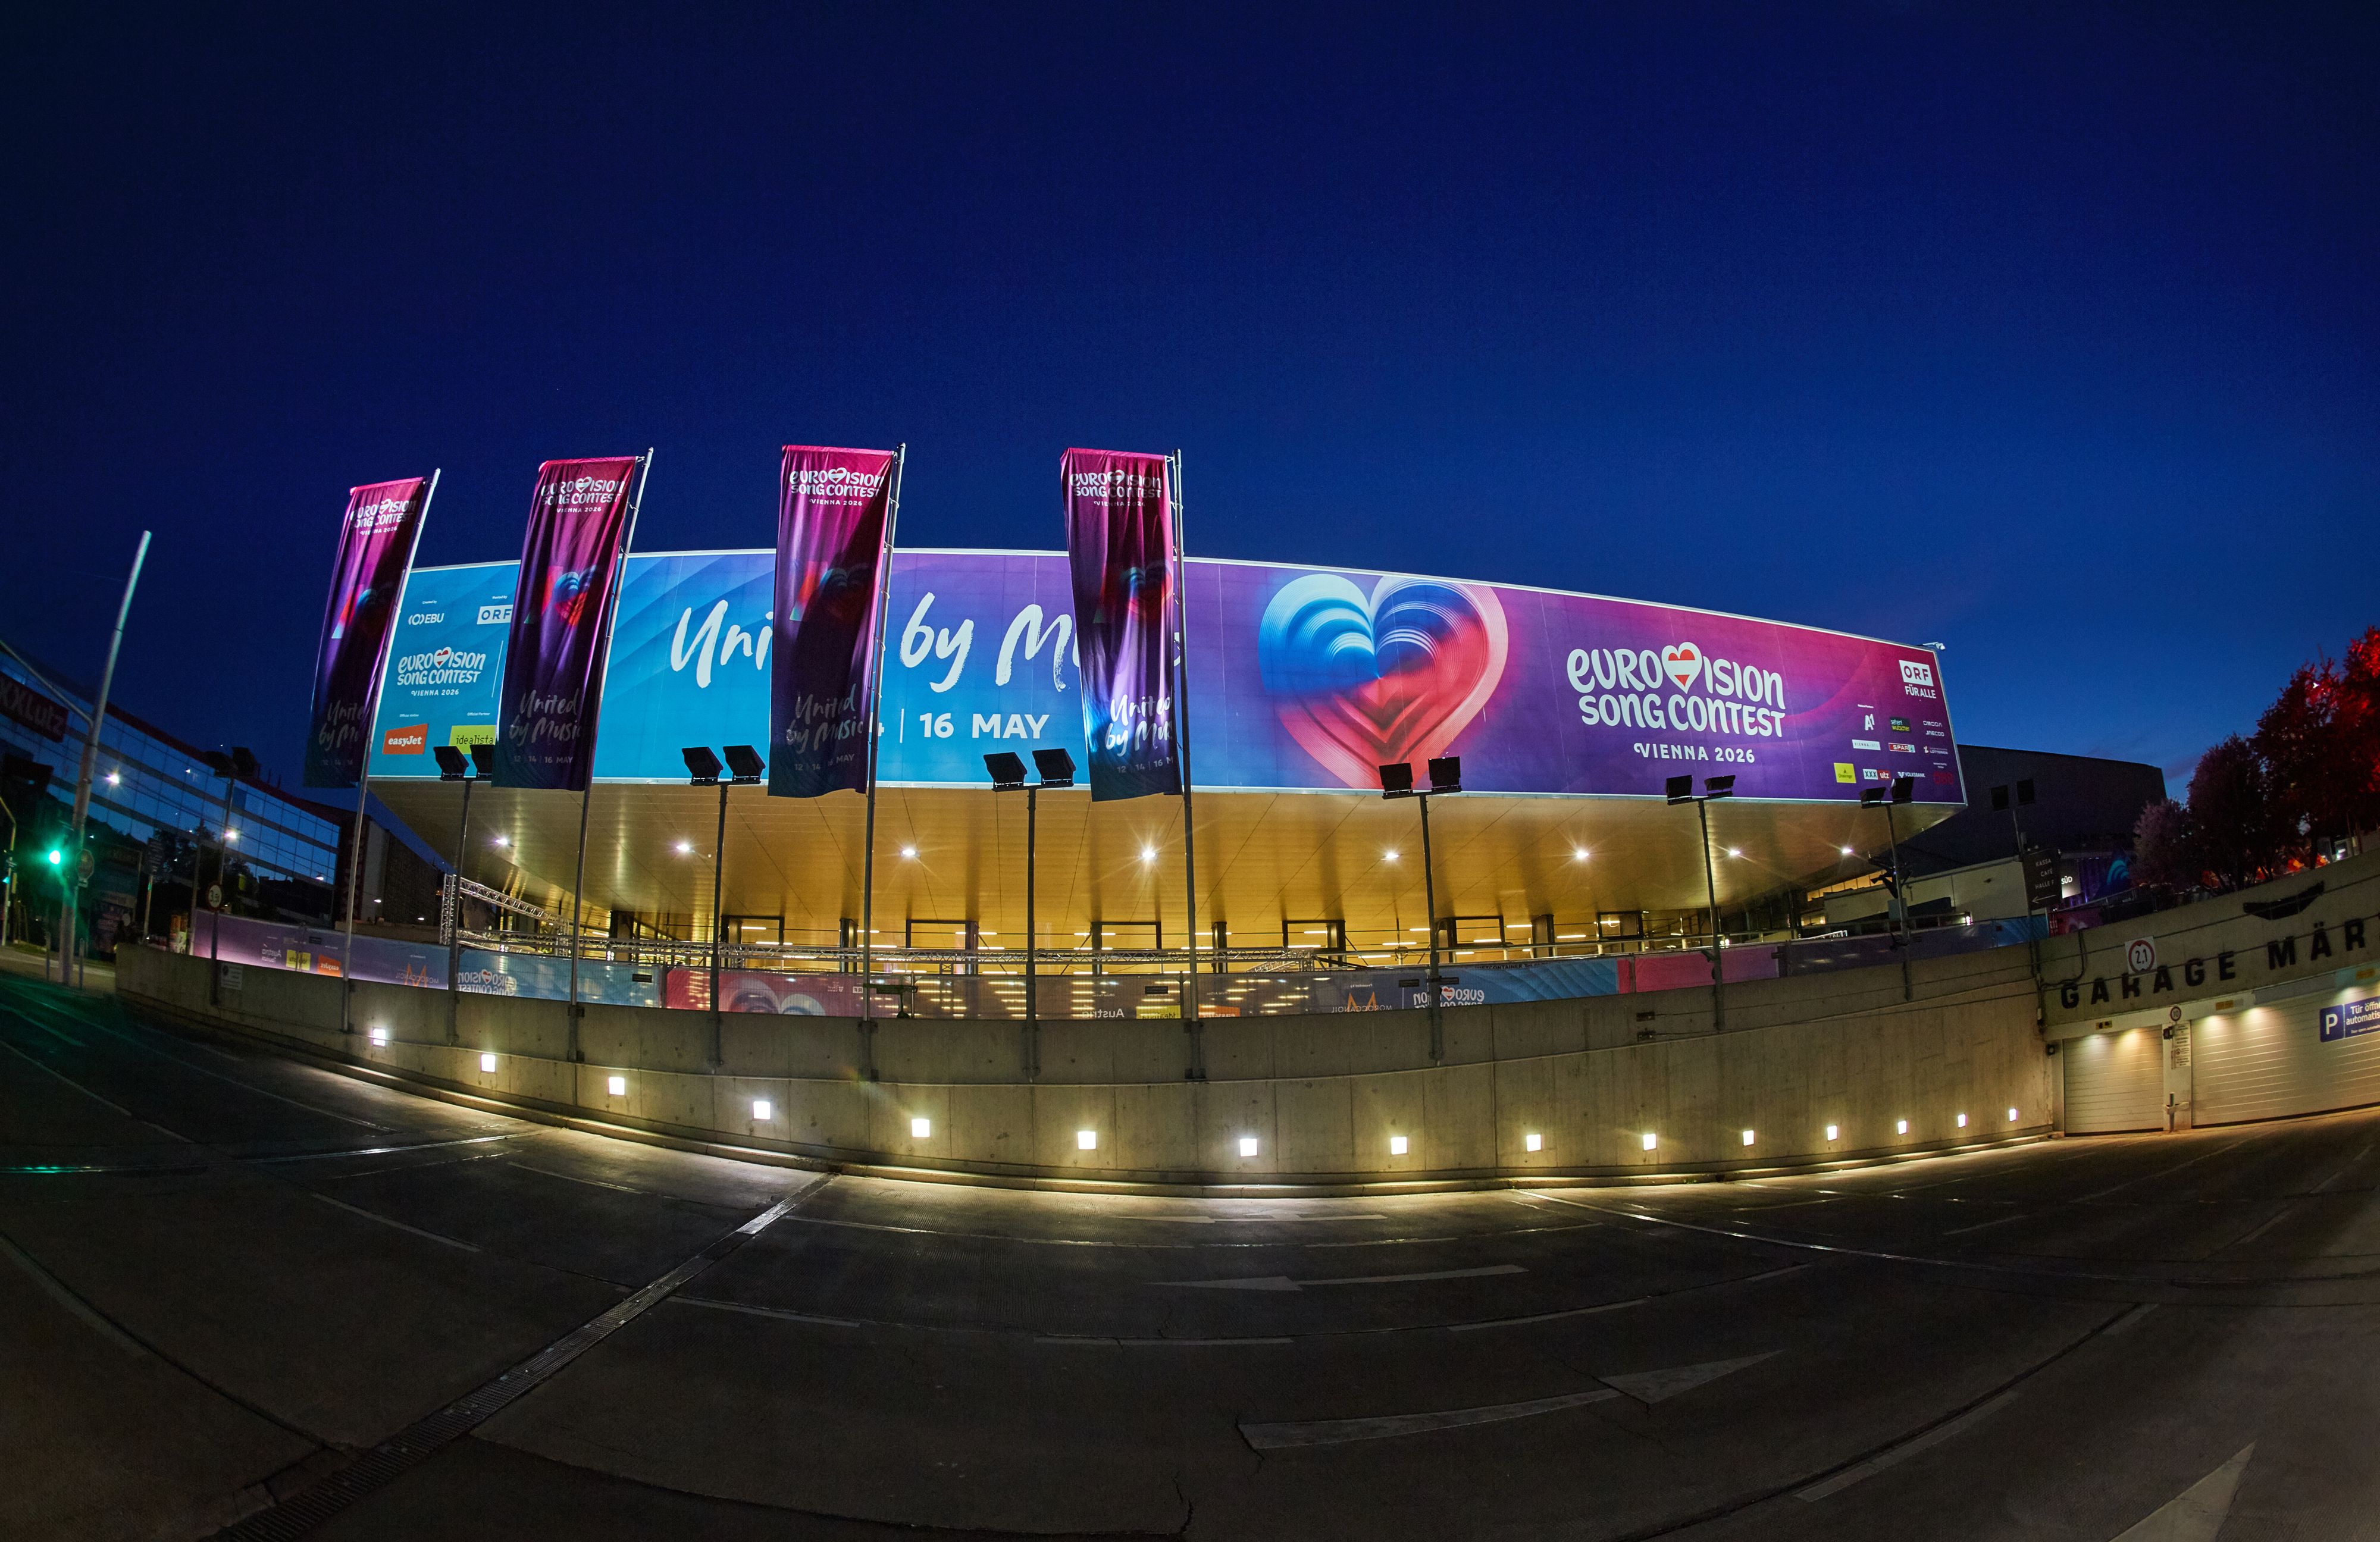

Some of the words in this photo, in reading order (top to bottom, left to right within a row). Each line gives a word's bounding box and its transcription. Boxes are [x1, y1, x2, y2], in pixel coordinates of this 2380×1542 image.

[791, 484, 825, 496] SONG
[826, 484, 879, 498] CONTEST
[1073, 486, 1107, 497] SONG
[424, 613, 444, 623] EBU
[481, 609, 512, 620] ORF
[671, 599, 773, 688] Uni
[900, 591, 974, 692] by
[397, 670, 427, 686] SONG
[428, 669, 481, 684] CONTEST
[1904, 665, 1930, 681] ORF
[1905, 684, 1919, 697] FÜR
[1919, 688, 1936, 699] ALLE
[520, 688, 579, 718] United
[1579, 693, 1666, 729] SONG
[1668, 694, 1786, 737] CONTEST
[1865, 713, 1875, 731] A1
[509, 714, 530, 747] by
[919, 713, 954, 738] 16
[972, 714, 1050, 739] MAY
[388, 735, 422, 747] easyJet
[456, 735, 494, 745] idealista
[787, 719, 810, 754] by
[1104, 723, 1129, 757] by
[836, 754, 855, 763] MAY
[1634, 742, 1708, 761] VIENNA
[1715, 747, 1755, 763] 2026
[1154, 759, 1163, 767] 16
[2035, 858, 2052, 867] KASSA
[2060, 876, 2073, 885] SÜD
[2060, 951, 2236, 1010] GARAGE
[2268, 918, 2366, 970] MÄR
[2350, 1005, 2363, 1015] Tür
[2326, 1013, 2338, 1035] P
